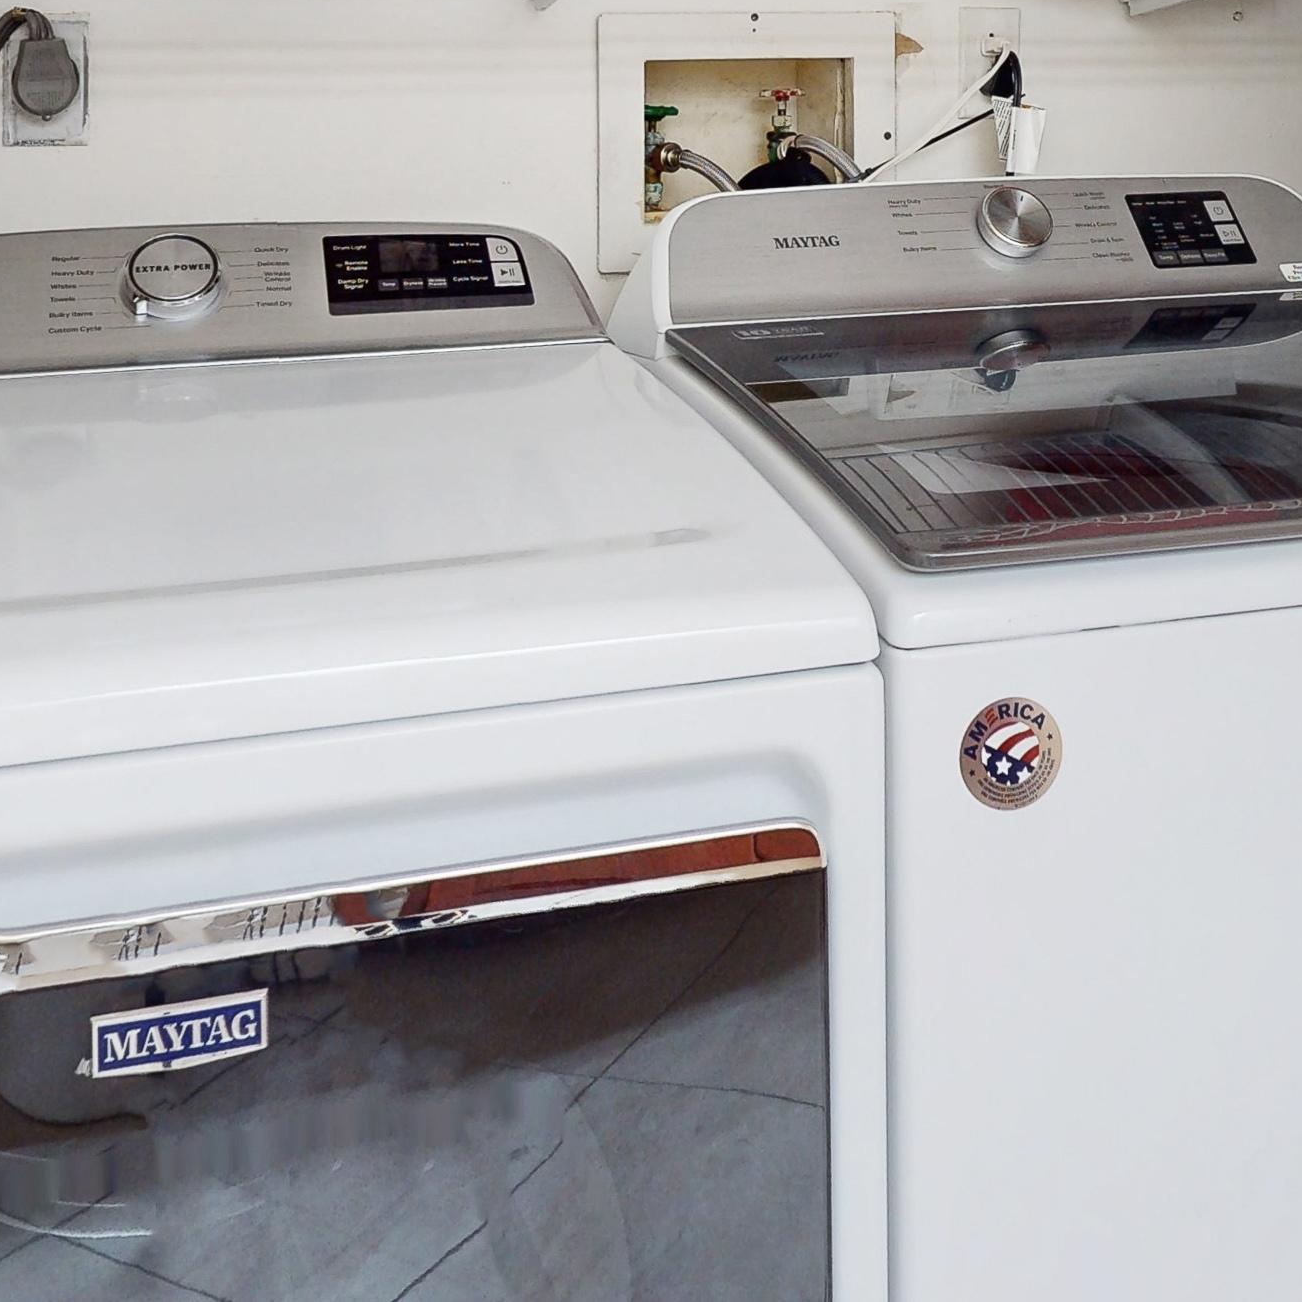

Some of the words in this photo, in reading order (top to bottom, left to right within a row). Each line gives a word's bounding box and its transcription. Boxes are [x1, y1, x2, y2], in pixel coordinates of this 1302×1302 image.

[772, 235, 841, 249] MAYTAG
[135, 265, 170, 273] EXTRA
[173, 263, 211, 271] POWER
[80, 325, 102, 333] Cycle
[963, 702, 1046, 761] AMERICA
[104, 1008, 258, 1064] MAYTAG
